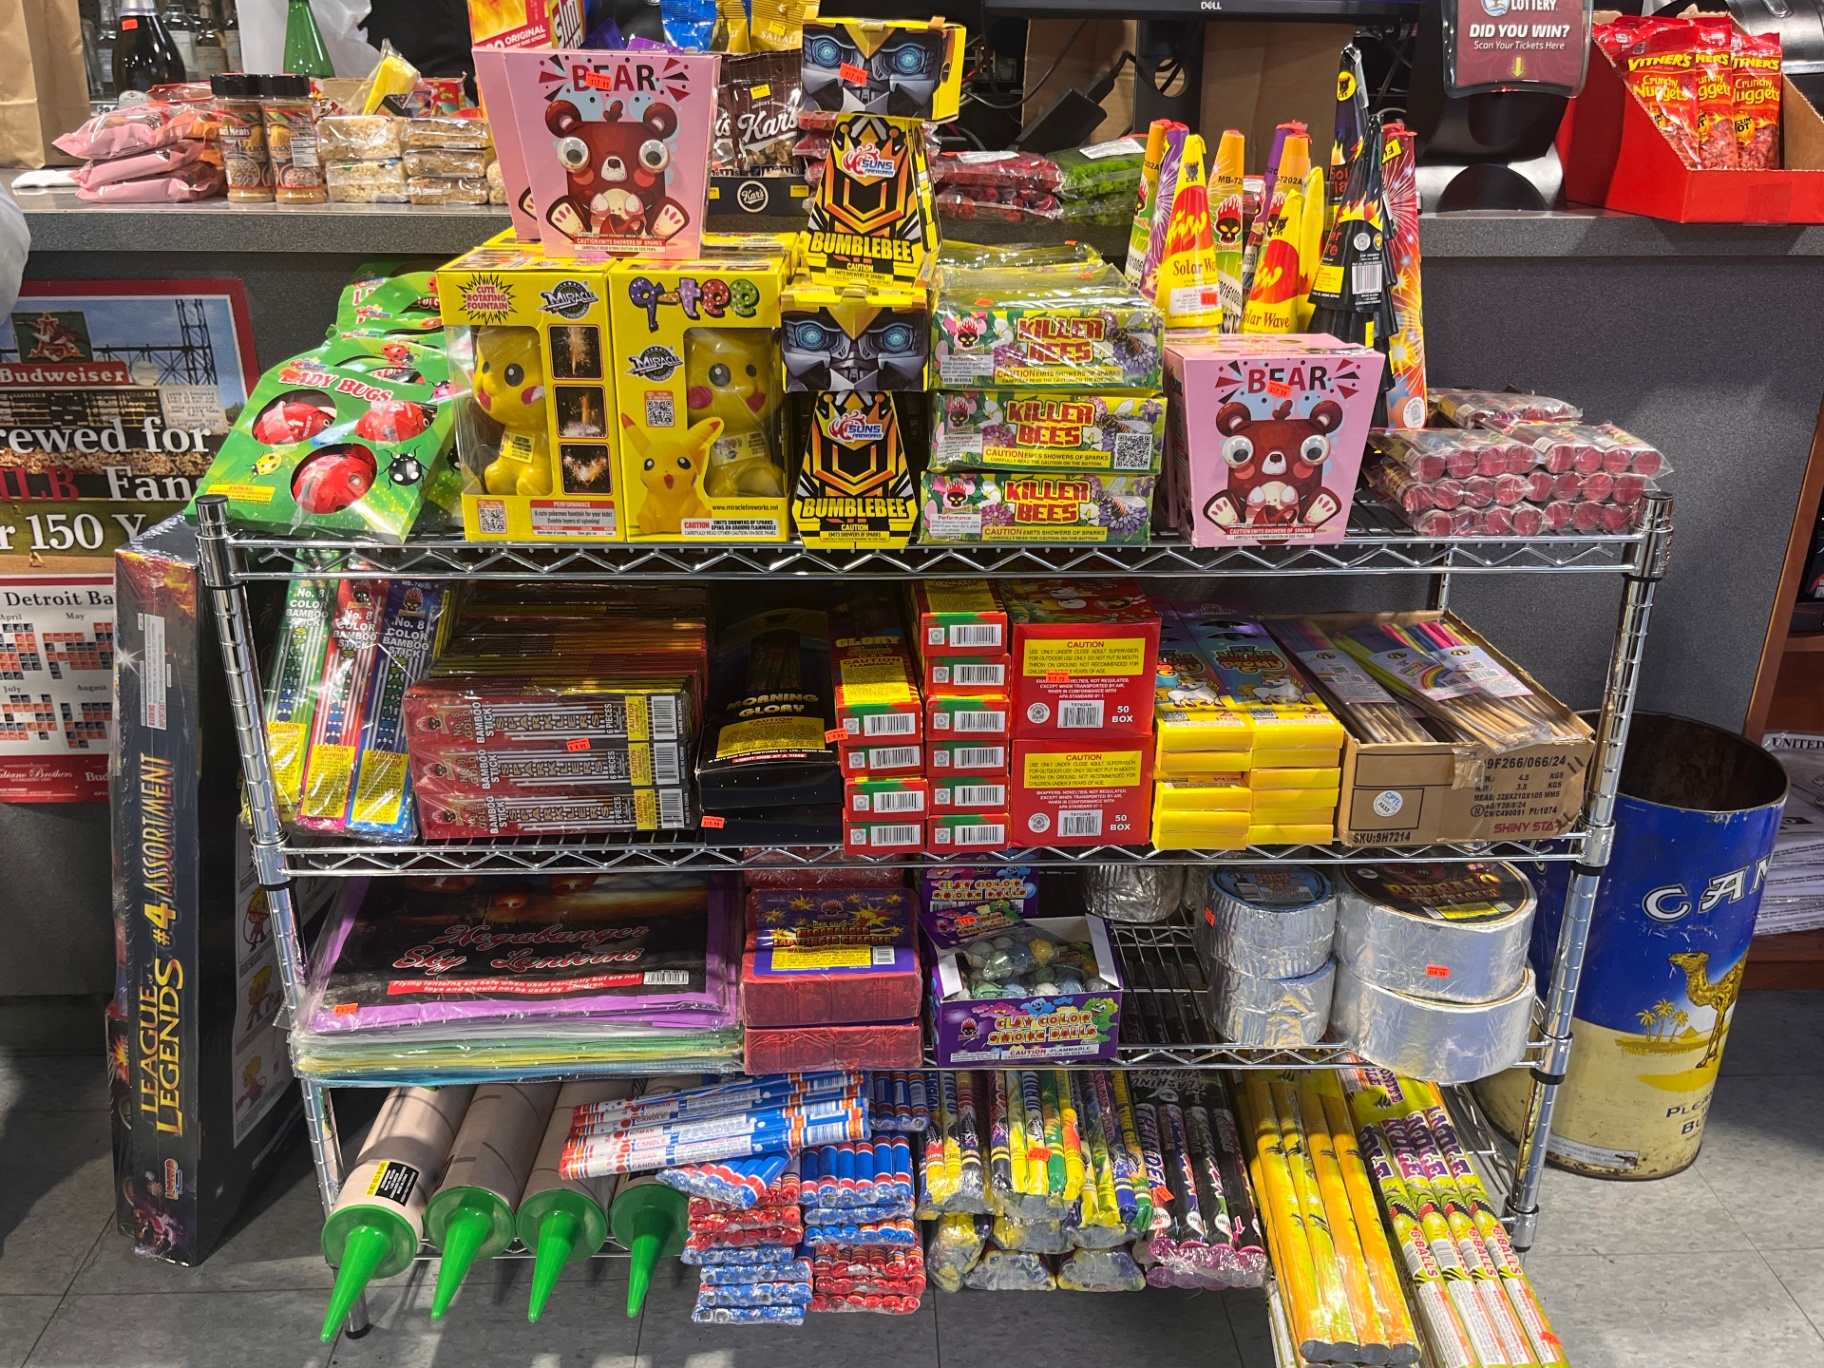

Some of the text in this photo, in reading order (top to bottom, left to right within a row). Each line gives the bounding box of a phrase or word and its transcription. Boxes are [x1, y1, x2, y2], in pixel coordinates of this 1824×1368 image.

[1201, 2, 1222, 10] DELL
[505, 25, 546, 45] ORIGINAL
[1469, 24, 1570, 38] DID YOU WIN?
[1474, 41, 1565, 50] Scan Your Tickets Here
[1628, 54, 1692, 71] VITNER'S
[1643, 76, 1678, 88] Crunchy
[1735, 78, 1772, 91] Crunchy
[861, 159, 895, 171] SUNS
[811, 231, 913, 263] BUMBLEBEE
[467, 294, 507, 302] ROTATING
[545, 291, 597, 304] MIRACLE
[467, 302, 508, 310] FOUNTAIN
[1264, 310, 1289, 328] Wave
[1019, 317, 1104, 342] KILLER
[1029, 342, 1092, 364] BEES
[632, 356, 681, 369] MIRACLE
[1, 368, 124, 384] Budweiser
[997, 369, 1036, 379] CAUTION
[338, 378, 394, 402] BUGS
[1008, 401, 1092, 424] KILLER
[142, 417, 211, 453] for
[849, 425, 881, 434] SUNS
[1018, 426, 1081, 446] BEES
[986, 449, 1024, 458] CAUTION
[1006, 481, 1089, 500] KILLER
[802, 498, 907, 518] BUMBLEBEE
[1016, 504, 1077, 523] BEES
[26, 513, 104, 550] 150
[985, 528, 1022, 536] CAUTION
[5, 592, 83, 606] Detroit
[297, 588, 314, 598] No.
[290, 600, 327, 609] COLOR
[66, 612, 84, 622] May
[286, 609, 329, 618] BAMBOO
[345, 609, 373, 620] No. 8
[291, 617, 321, 627] STICK
[337, 621, 375, 632] COLOR
[394, 616, 424, 630] No. 8
[333, 631, 376, 641] BAMBOO
[387, 628, 428, 641] COLOR
[835, 636, 900, 647] GLORY
[338, 639, 369, 649] STICK
[383, 636, 429, 650] BAMBOO
[1067, 641, 1104, 649] CAUTION
[388, 646, 422, 658] STICK
[4, 684, 107, 694] July August
[726, 693, 818, 711] MORNING
[604, 704, 613, 727] PIECES
[739, 704, 804, 717] GLORY
[465, 709, 474, 738] GOLD
[473, 701, 486, 744] BAMBOO
[485, 707, 495, 737] STICK
[496, 714, 600, 730] SPARKLERS
[29, 767, 73, 778] Brothers
[470, 756, 480, 784] GOLD
[479, 749, 491, 790] BAMBOO
[490, 754, 500, 784] STICK
[502, 761, 603, 775] SPARKLERS
[508, 806, 610, 822] SPARKLERS
[1529, 806, 1557, 815] PI:1074
[1493, 822, 1530, 833] SHINY
[1353, 831, 1411, 843] SKU:SH7214
[140, 753, 176, 946] #4 ASSORTMENT
[939, 879, 1022, 889] CLAY COLOR
[933, 889, 1027, 900] SMOKE BALLS
[796, 927, 870, 937] MEGABANGER
[773, 936, 892, 946] LADYFINGER CRACKER
[393, 944, 646, 975] Sky Lanterns
[997, 1011, 1092, 1030] CLAY COLOR
[989, 1026, 1097, 1045] SMOKE BALLS
[140, 985, 158, 1114] LEAGUE
[155, 958, 184, 1137] LEGENDS
[1131, 1079, 1205, 1093] FLASHING
[630, 1128, 667, 1148] ROMAN CANDLE
